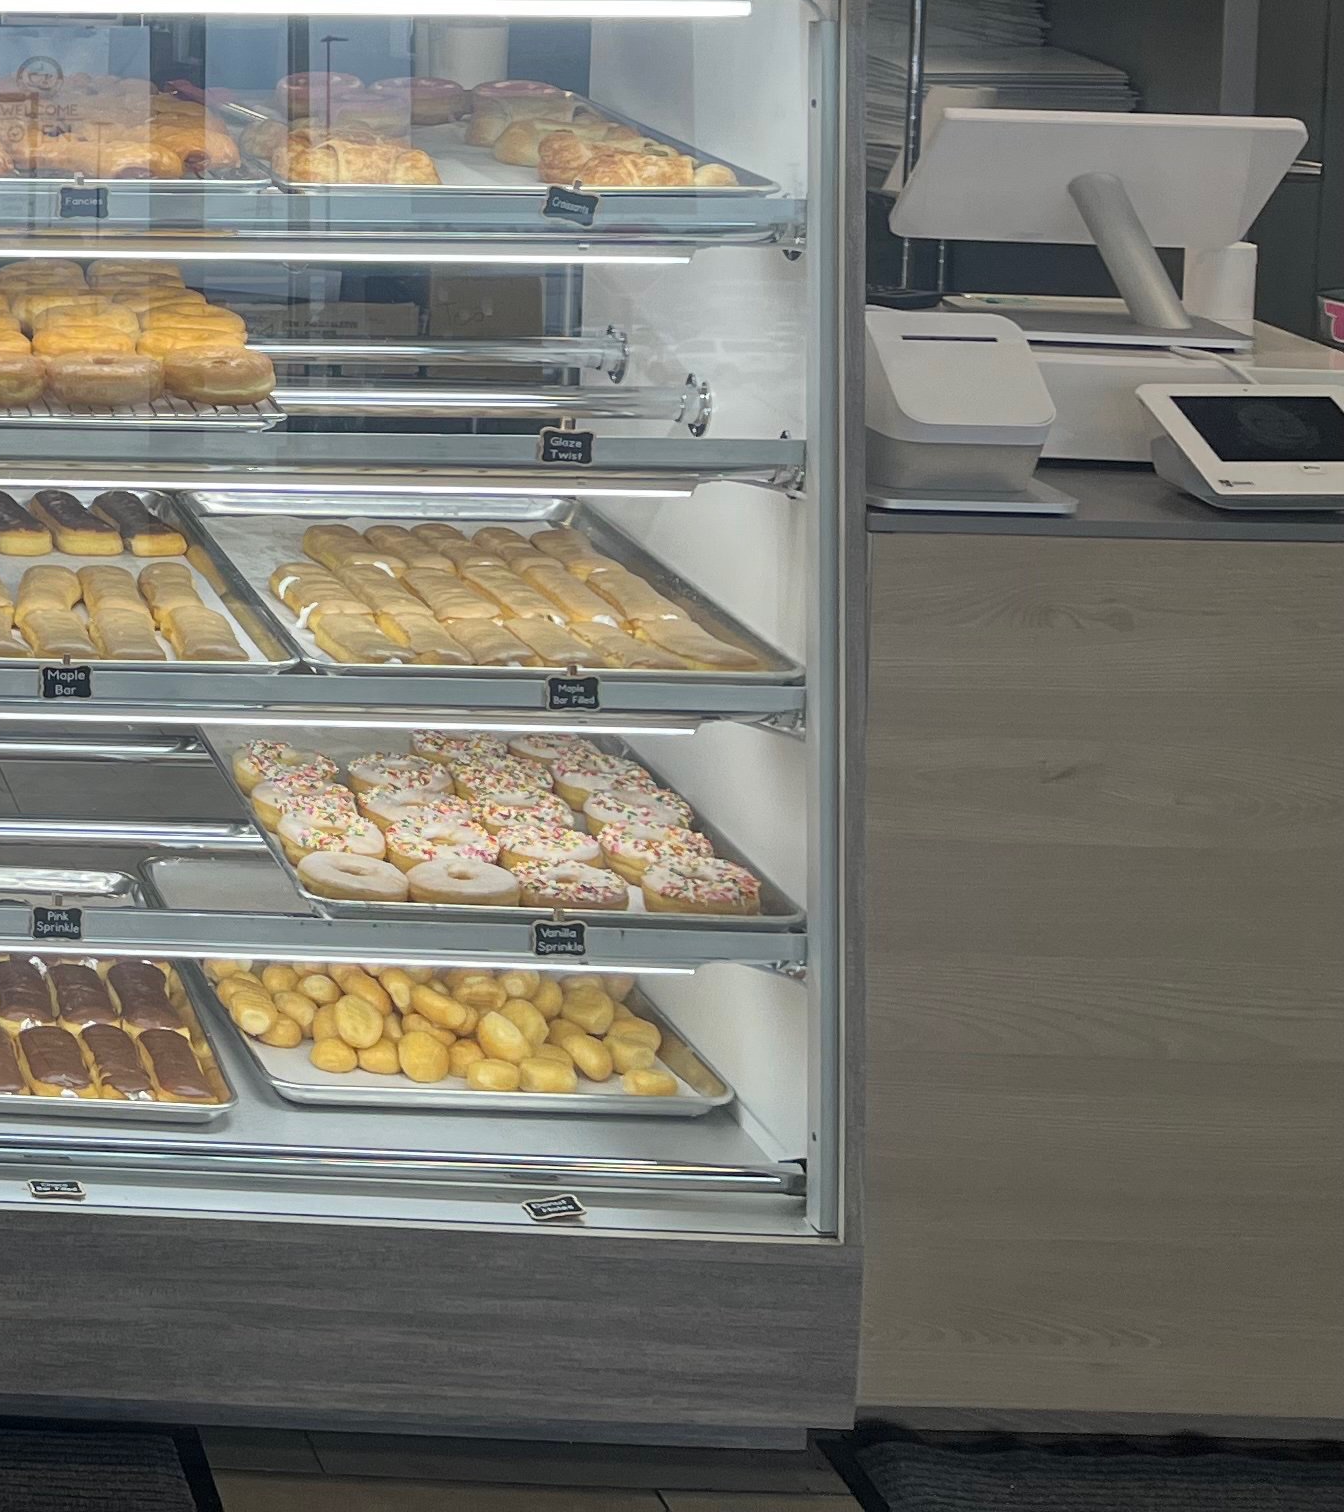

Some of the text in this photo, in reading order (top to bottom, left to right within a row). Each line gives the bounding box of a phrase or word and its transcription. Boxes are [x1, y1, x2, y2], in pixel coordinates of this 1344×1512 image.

[65, 196, 104, 206] Fancies
[549, 436, 583, 449] Glaze
[549, 449, 583, 461] Twist
[47, 669, 86, 683] Maple
[54, 684, 77, 695] Bar
[557, 684, 585, 694] Maple
[552, 695, 596, 705] Bar Filled
[47, 910, 70, 921] Pink
[36, 921, 80, 933] Sprinkle
[540, 928, 577, 938] Vanilla
[537, 941, 584, 953] Sprinkle
